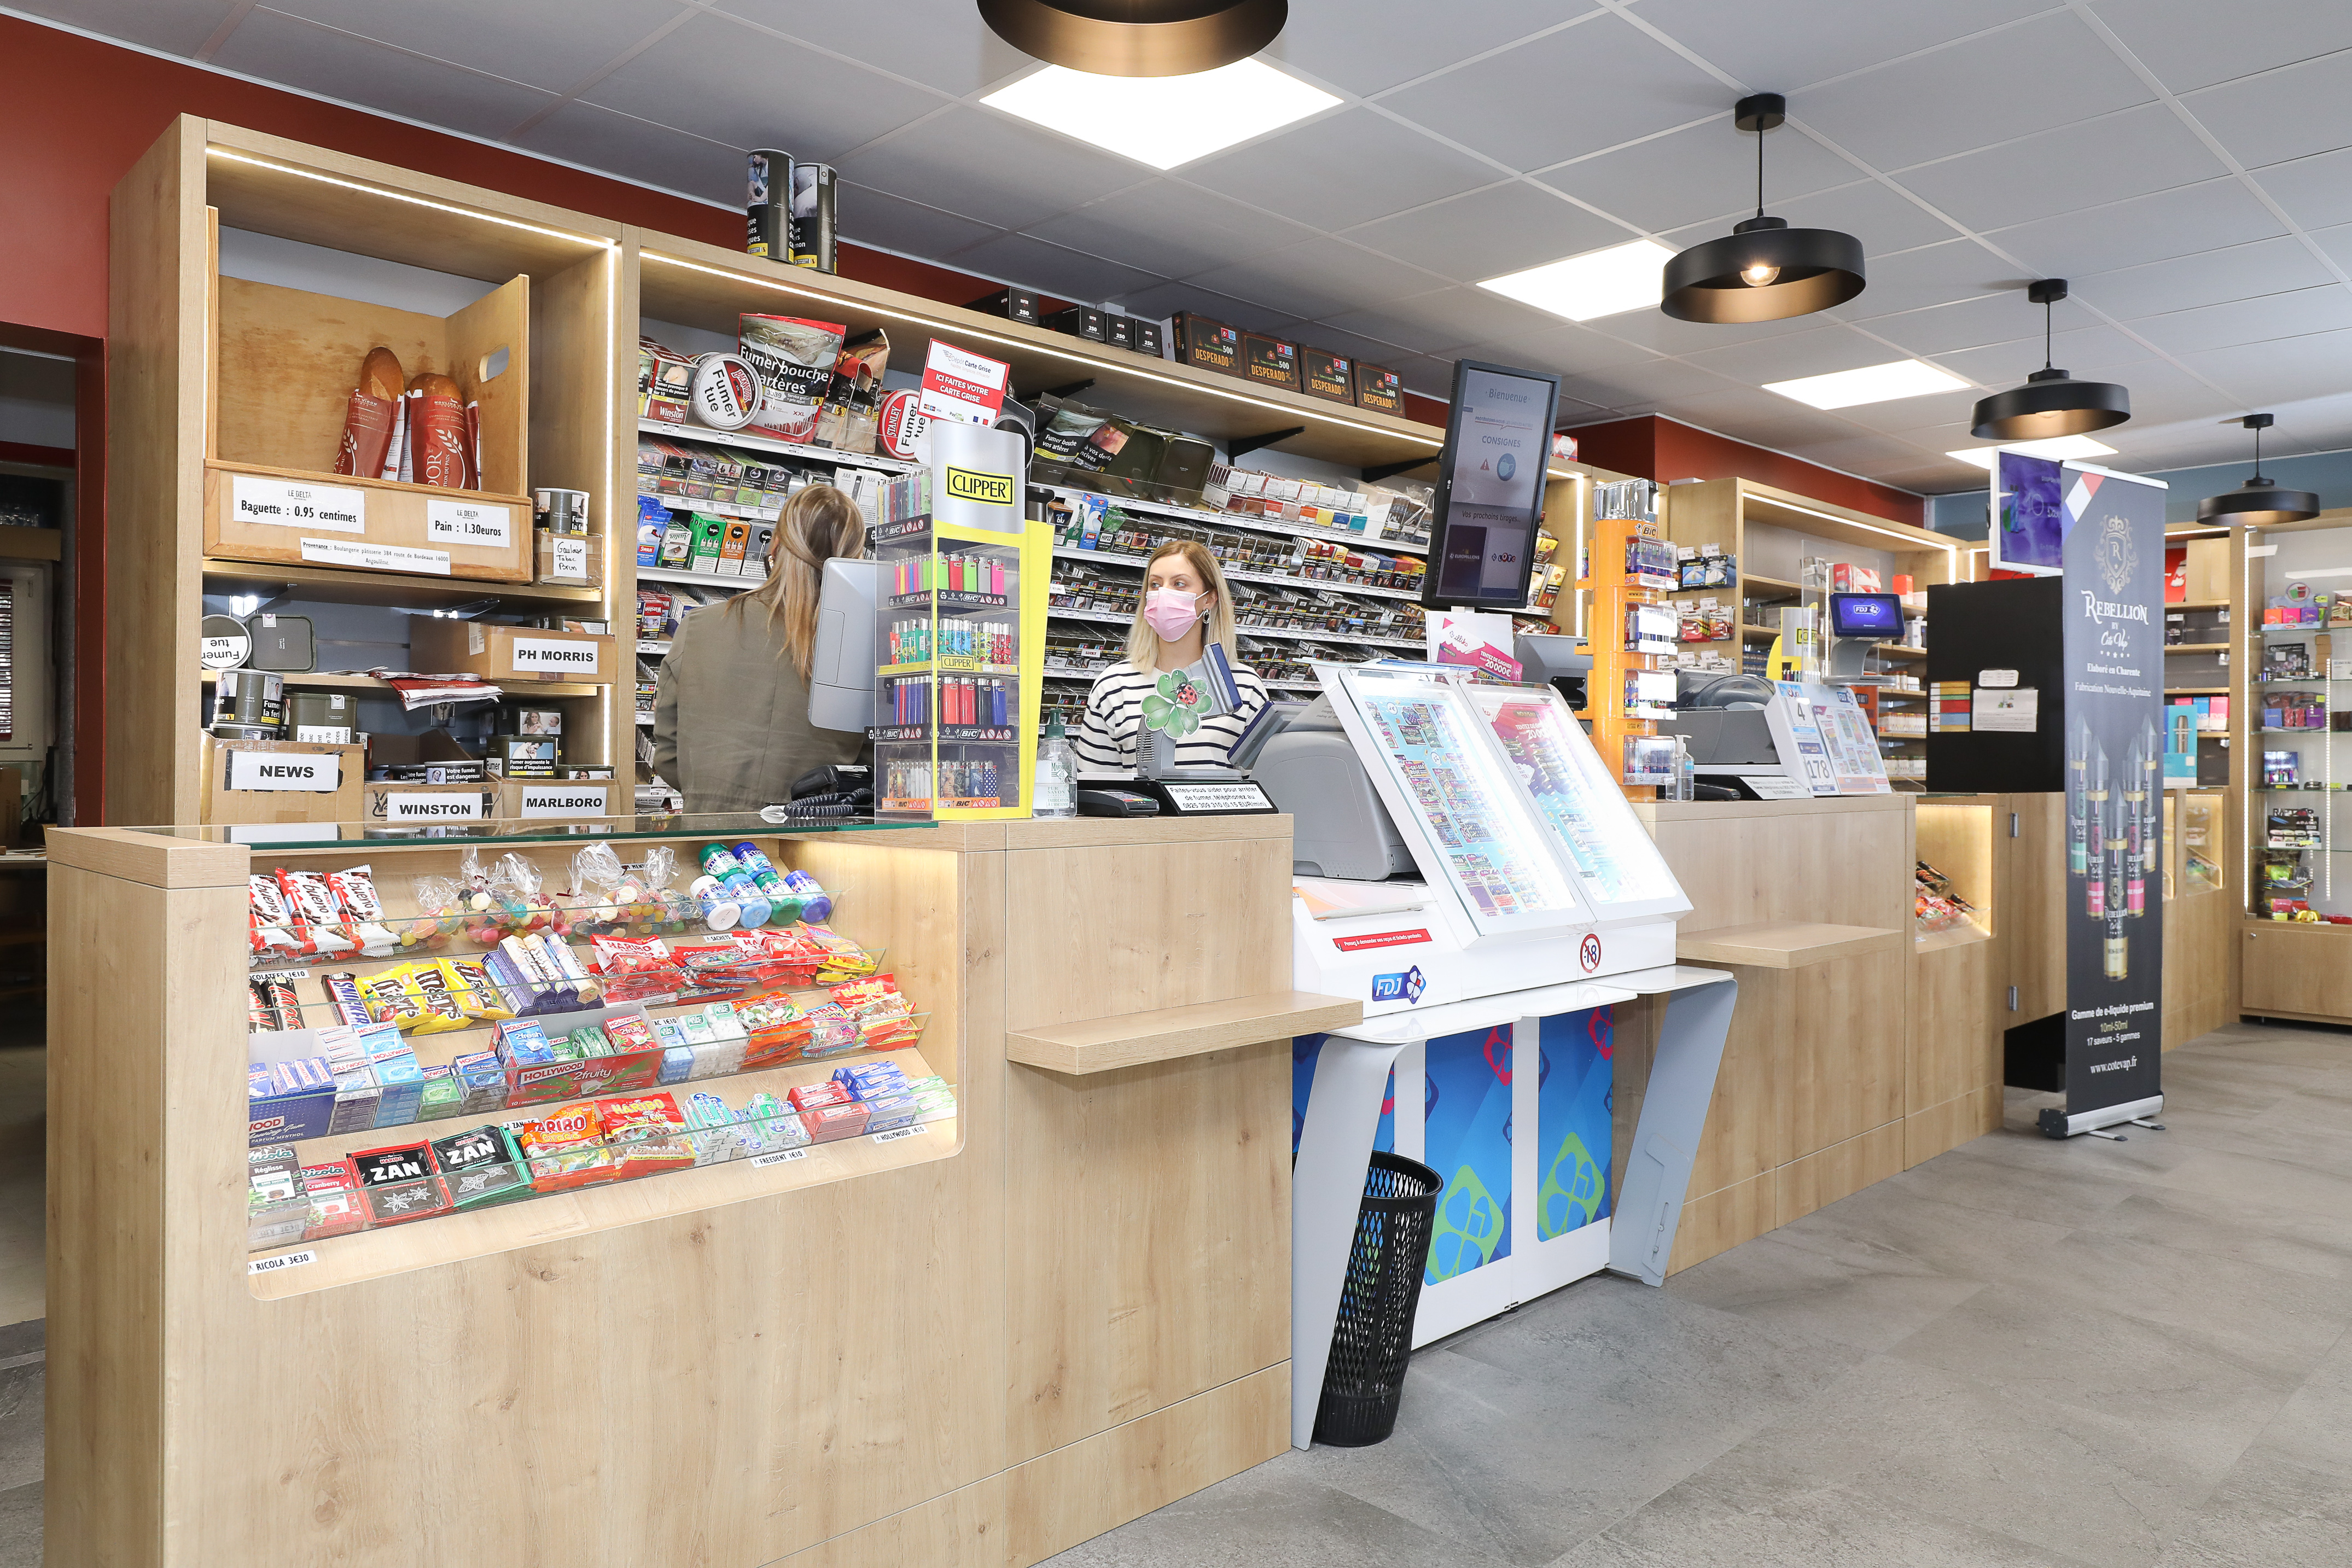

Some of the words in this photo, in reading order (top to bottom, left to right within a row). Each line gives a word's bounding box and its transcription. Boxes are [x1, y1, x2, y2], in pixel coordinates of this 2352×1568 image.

[1222, 345, 1233, 354] 500
[741, 345, 780, 370] Fumer
[780, 366, 829, 382] bouche
[1196, 348, 1229, 367] DESPERADO
[965, 360, 977, 369] Carte
[979, 363, 991, 373] Grise
[1251, 364, 1285, 381] DESPERADO
[1279, 361, 1289, 370] 500
[731, 369, 753, 403] BACKWOODS
[760, 375, 806, 394] artères
[936, 374, 944, 382] ICI
[945, 377, 965, 389] FAITES
[967, 383, 988, 396] VOTRE
[705, 387, 719, 412] tue
[713, 369, 736, 417] Fumer
[940, 385, 960, 397] CARTE
[961, 392, 981, 403] GRISE
[660, 406, 684, 419] Winston
[887, 406, 901, 437] STANLEY
[901, 403, 917, 446] Fumer
[914, 417, 925, 438] tue
[1043, 440, 1051, 448] vos
[1052, 444, 1069, 453] artères
[1045, 434, 1060, 443] Fumer
[1062, 439, 1076, 447] bouche
[1482, 436, 1521, 447] CONSIGNES
[953, 475, 1006, 498] CLIPPER
[296, 490, 312, 499] DELTA
[241, 500, 281, 515] Baguette
[294, 506, 313, 518] 0.95
[319, 510, 357, 523] centimes
[1474, 511, 1498, 521] prochains
[435, 521, 452, 532] Pain
[465, 523, 501, 537] 1.30euros
[303, 541, 328, 550] Provenance
[334, 545, 359, 553] Boulangerie
[362, 547, 381, 556] pâtisserie
[558, 563, 577, 572] Brun
[2081, 590, 2149, 625] REBELLION
[1454, 634, 1468, 647] illiko
[519, 649, 537, 661] PH
[540, 650, 593, 662] MORRIS
[944, 658, 971, 668] CLIPPER
[1481, 651, 1494, 660] TENTEZ
[1498, 658, 1512, 669] GAGNER
[2116, 666, 2140, 677] Charente
[2075, 681, 2103, 693] Fabrication
[2104, 684, 2151, 698] Nouvelle-Aquitaine
[1798, 702, 1805, 720] 4
[961, 730, 978, 738] BIC
[260, 766, 314, 779] NEWS
[1807, 760, 1830, 779] 178
[399, 805, 471, 815] WINSTON
[526, 798, 602, 807] MARLBORO
[255, 883, 280, 913] bueno
[302, 884, 329, 913] bueno
[1376, 977, 1402, 996] FDJ
[2072, 1010, 2095, 1020] Gamme
[2095, 1007, 2103, 1017] de
[2104, 1004, 2129, 1017] e-liquide
[2129, 1001, 2153, 1014] premium
[504, 1021, 538, 1031] HOLLYWOOD
[2100, 1020, 2128, 1033] 10ml-50ml
[514, 1031, 543, 1039] 2fresh
[2087, 1037, 2093, 1046] 17
[2093, 1036, 2112, 1045] saveurs
[2116, 1034, 2120, 1042] 5
[2120, 1032, 2140, 1043] gammes
[373, 1048, 411, 1060] HOLLYWOOD
[459, 1053, 495, 1064] HOLLYWOOD
[523, 1062, 583, 1081] HOLLYWOOD
[2090, 1056, 2137, 1074] www.cotevap.fr
[573, 1068, 612, 1081] 2fruity
[612, 1099, 665, 1115] HARIBO
[696, 1094, 715, 1120] Freedent
[882, 1129, 910, 1140] HOLLYWOOD
[760, 1155, 786, 1164] FREEDENT
[254, 1165, 283, 1174] Réglisse
[302, 1166, 345, 1179] Ricola
[370, 1162, 422, 1181] ZAN
[307, 1180, 340, 1190] Cranberry
[256, 1258, 284, 1272] RICOLA
[288, 1254, 309, 1264] 3€30
